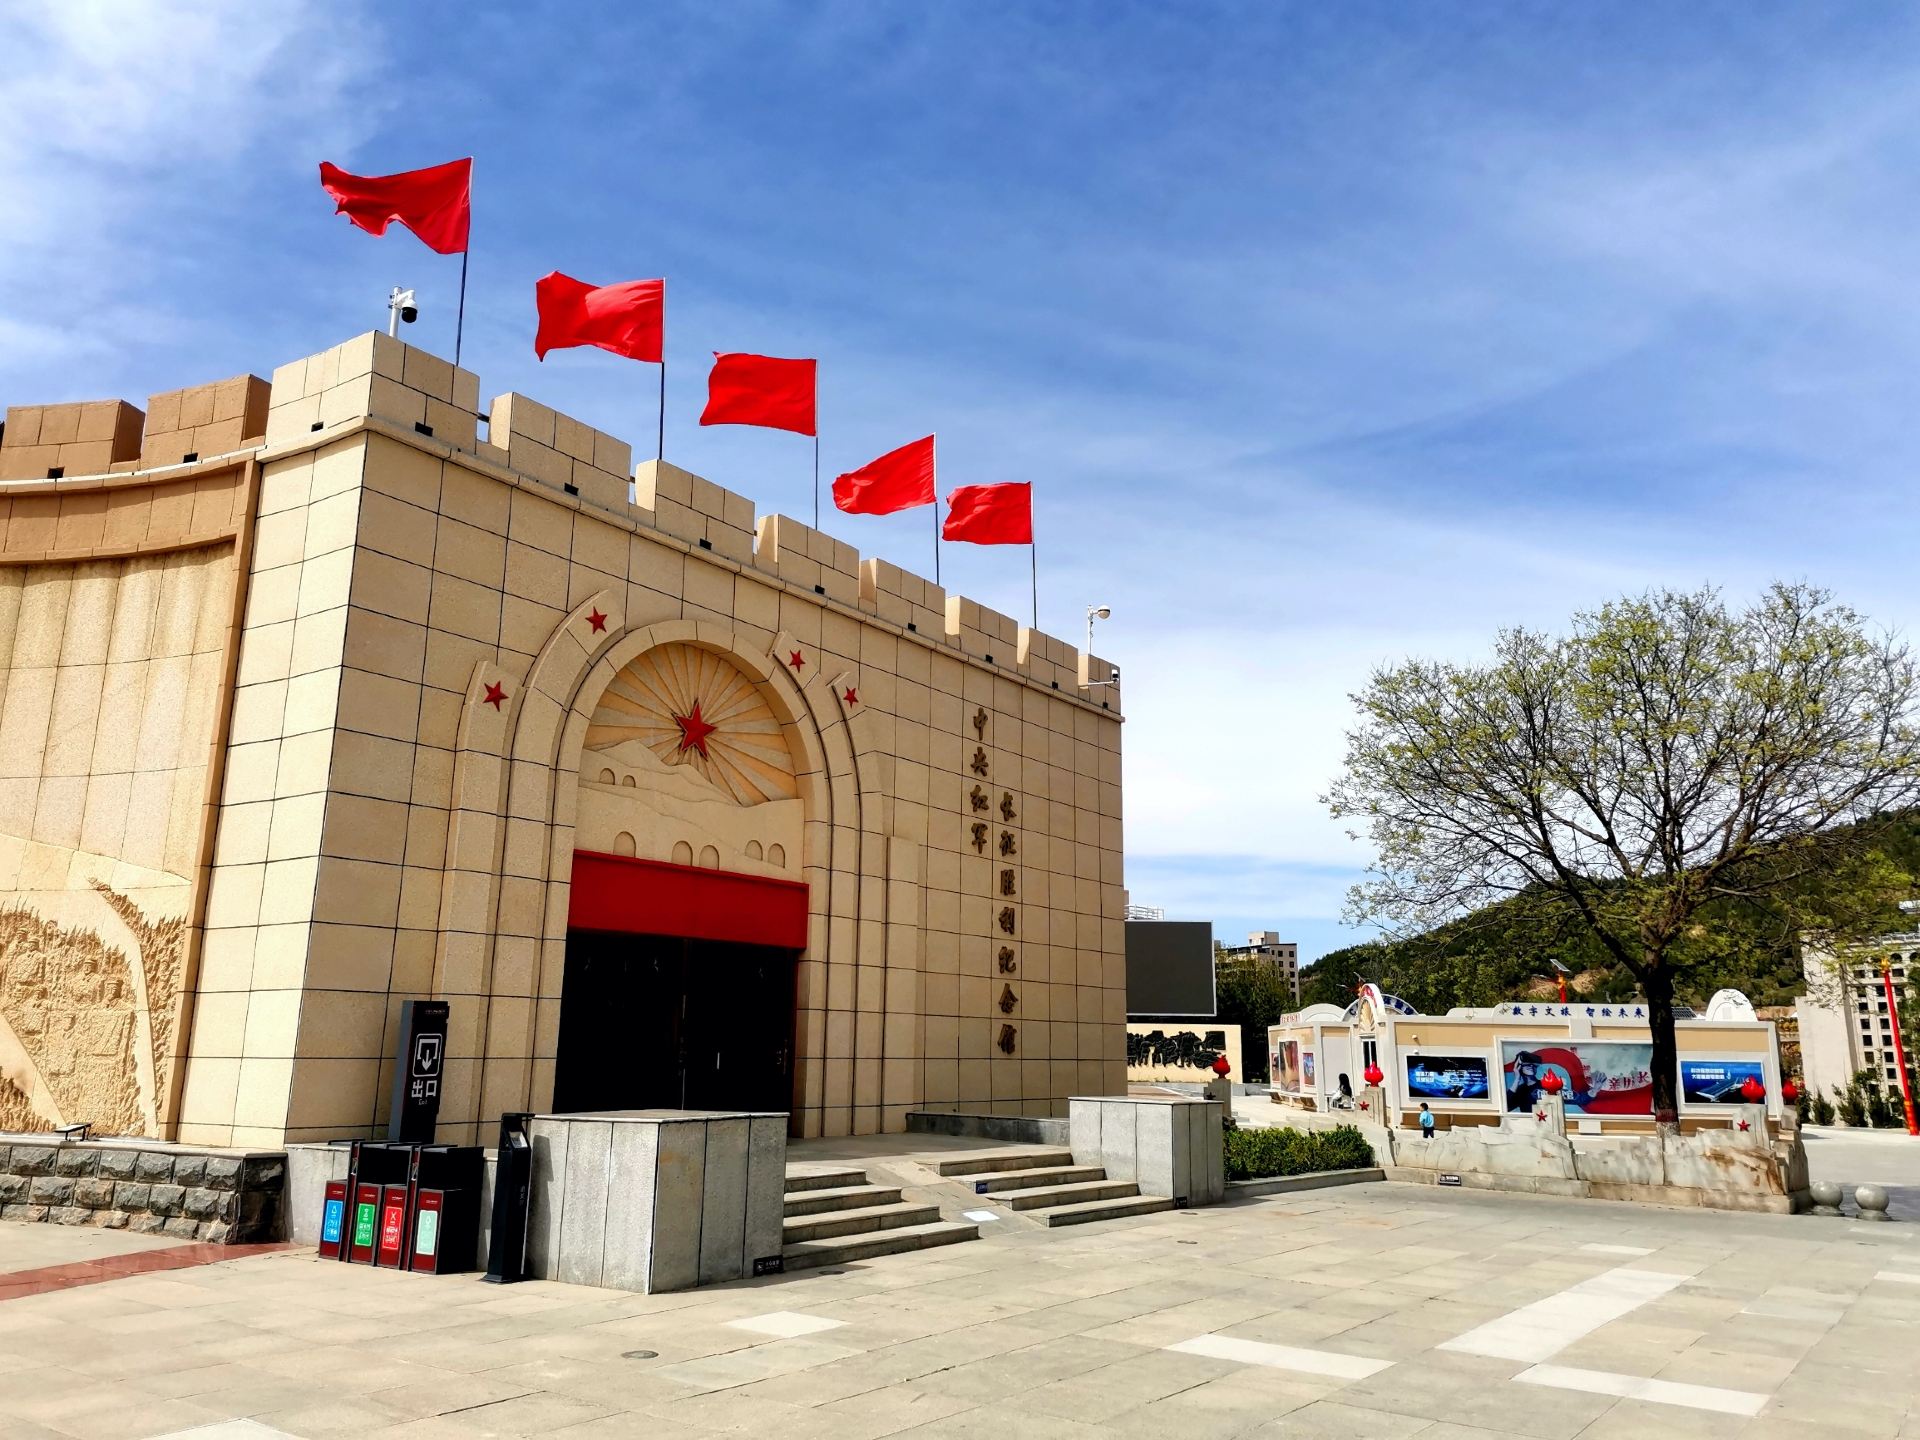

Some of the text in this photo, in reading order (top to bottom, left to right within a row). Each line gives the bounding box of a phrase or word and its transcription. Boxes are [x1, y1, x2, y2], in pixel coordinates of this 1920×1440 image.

[1512, 1004, 1646, 1019] 数字文旅 智绘未来
[411, 1079, 438, 1098] 出口
